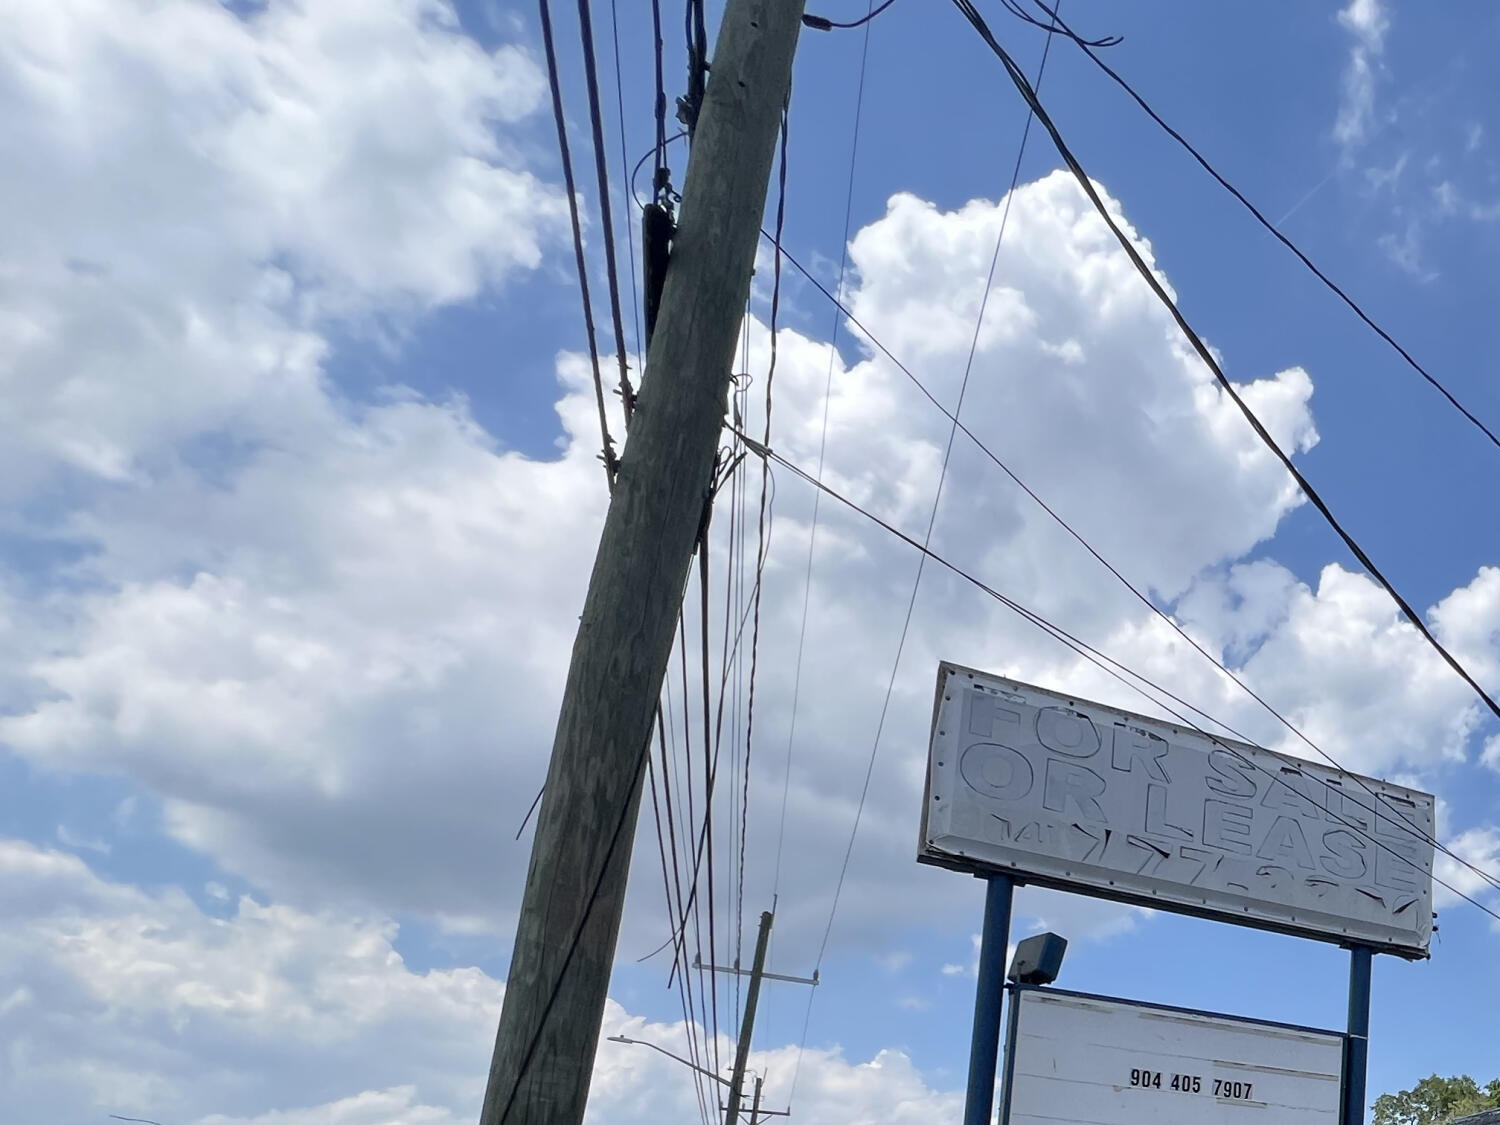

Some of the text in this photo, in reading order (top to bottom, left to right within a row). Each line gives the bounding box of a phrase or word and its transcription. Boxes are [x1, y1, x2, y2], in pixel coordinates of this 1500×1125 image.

[959, 742, 1108, 823] OR
[1144, 783, 1421, 895] LEASE
[968, 685, 1417, 842] FOR SALE
[1130, 1068, 1253, 1100] 904 405 7907
